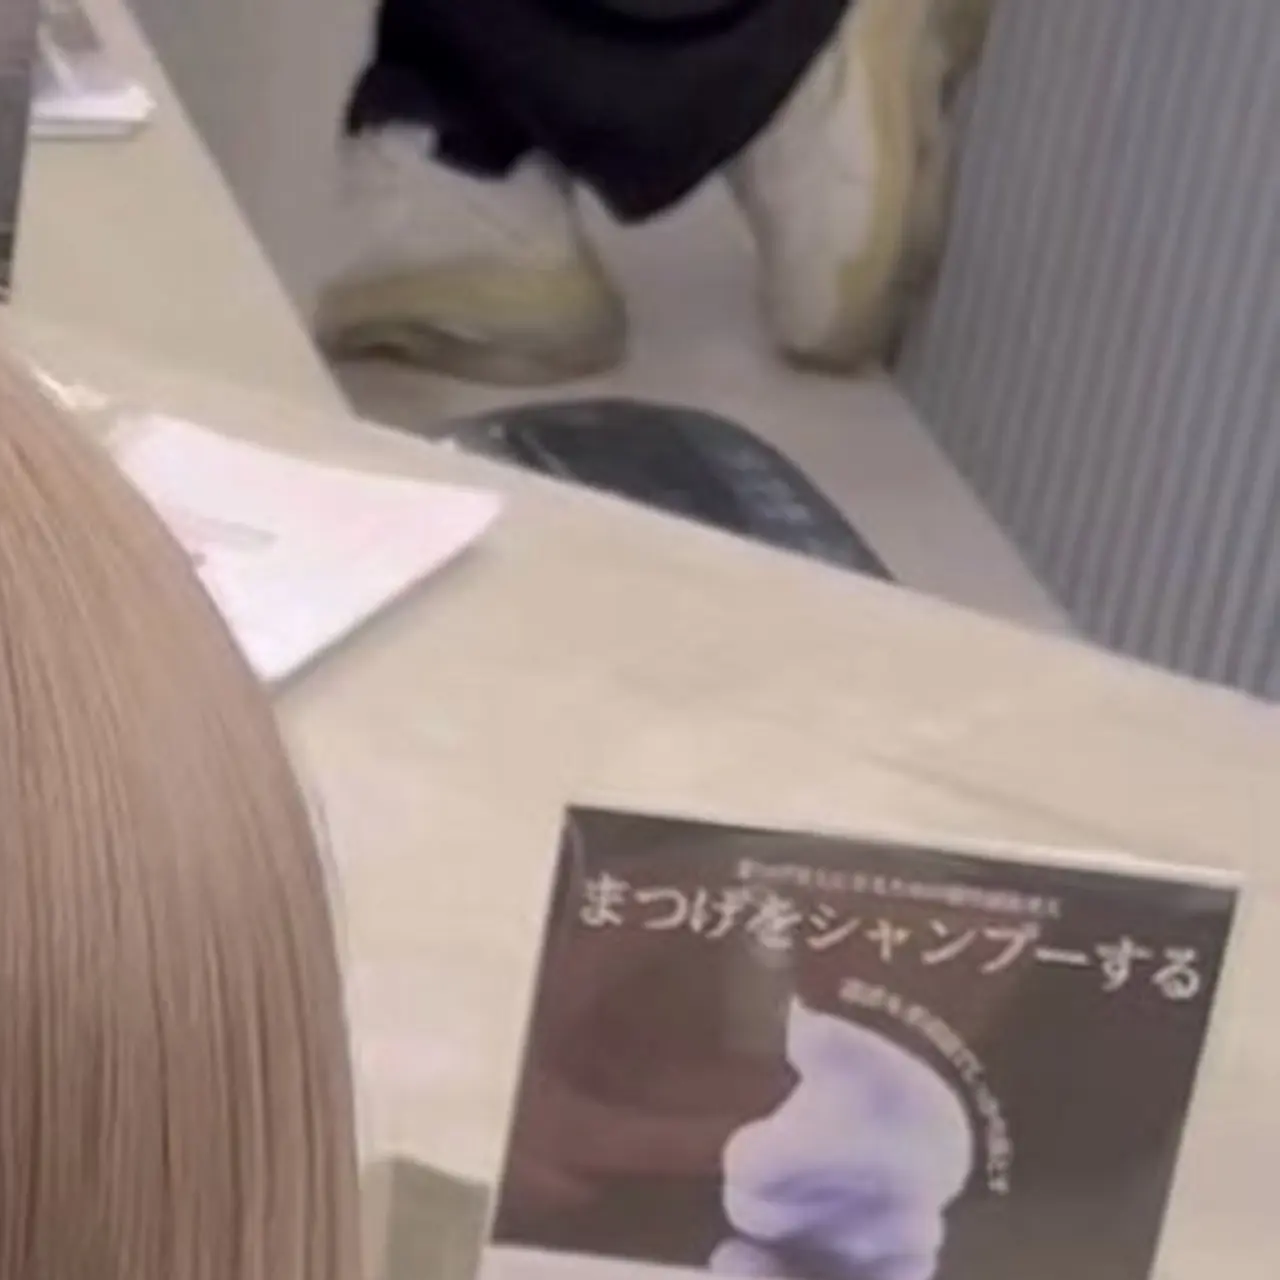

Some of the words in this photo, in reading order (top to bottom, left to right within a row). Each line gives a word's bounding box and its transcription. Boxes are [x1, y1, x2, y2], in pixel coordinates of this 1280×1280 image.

[579, 872, 1202, 1000] まつげをシャンプーする
